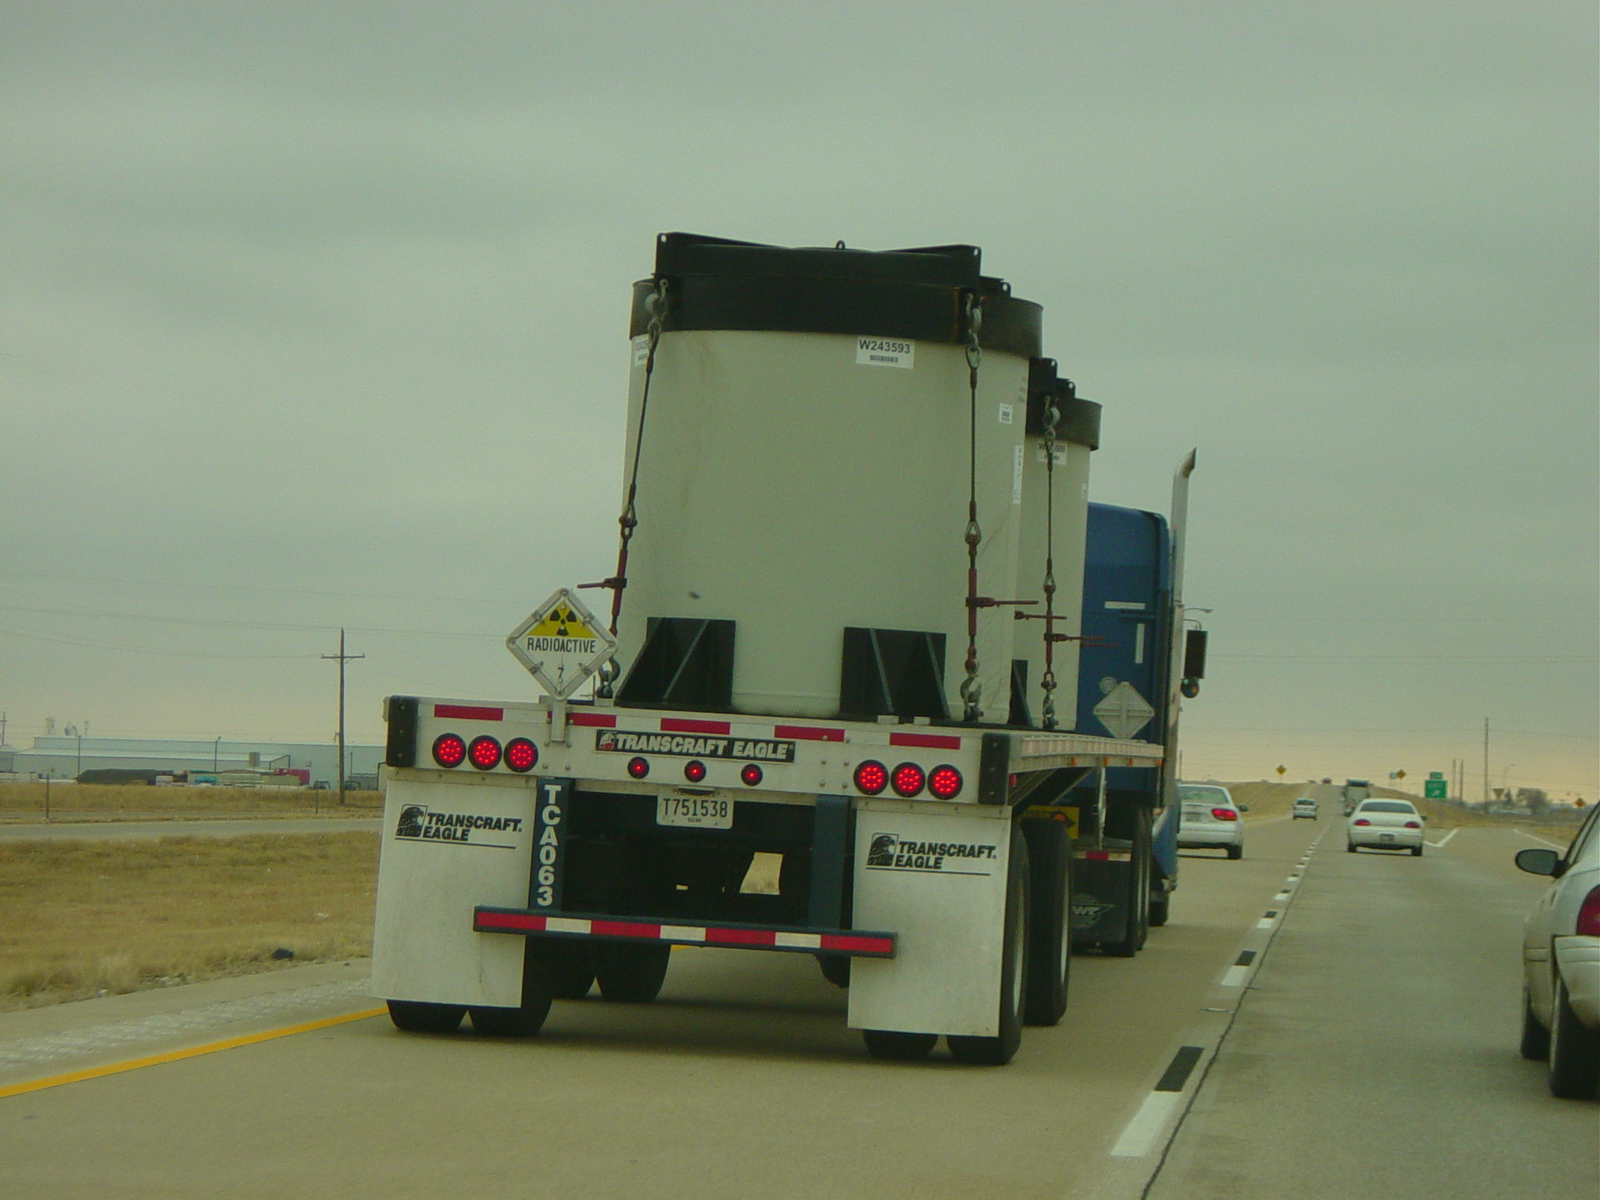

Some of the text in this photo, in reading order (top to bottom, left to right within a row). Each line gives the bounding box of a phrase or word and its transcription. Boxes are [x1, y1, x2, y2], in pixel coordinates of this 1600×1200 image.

[859, 339, 911, 354] W243593
[527, 637, 596, 653] RADIOACTIVE
[557, 666, 565, 680] 7
[616, 733, 790, 760] TRANSCRAFT EAGLE
[663, 798, 728, 818] T751538
[427, 812, 522, 833] TRANSCRAFT
[422, 826, 471, 842] EAGLE
[537, 784, 562, 907] TCA063
[898, 840, 996, 859] TRANSCRAFT
[895, 855, 944, 870] EAGLE
